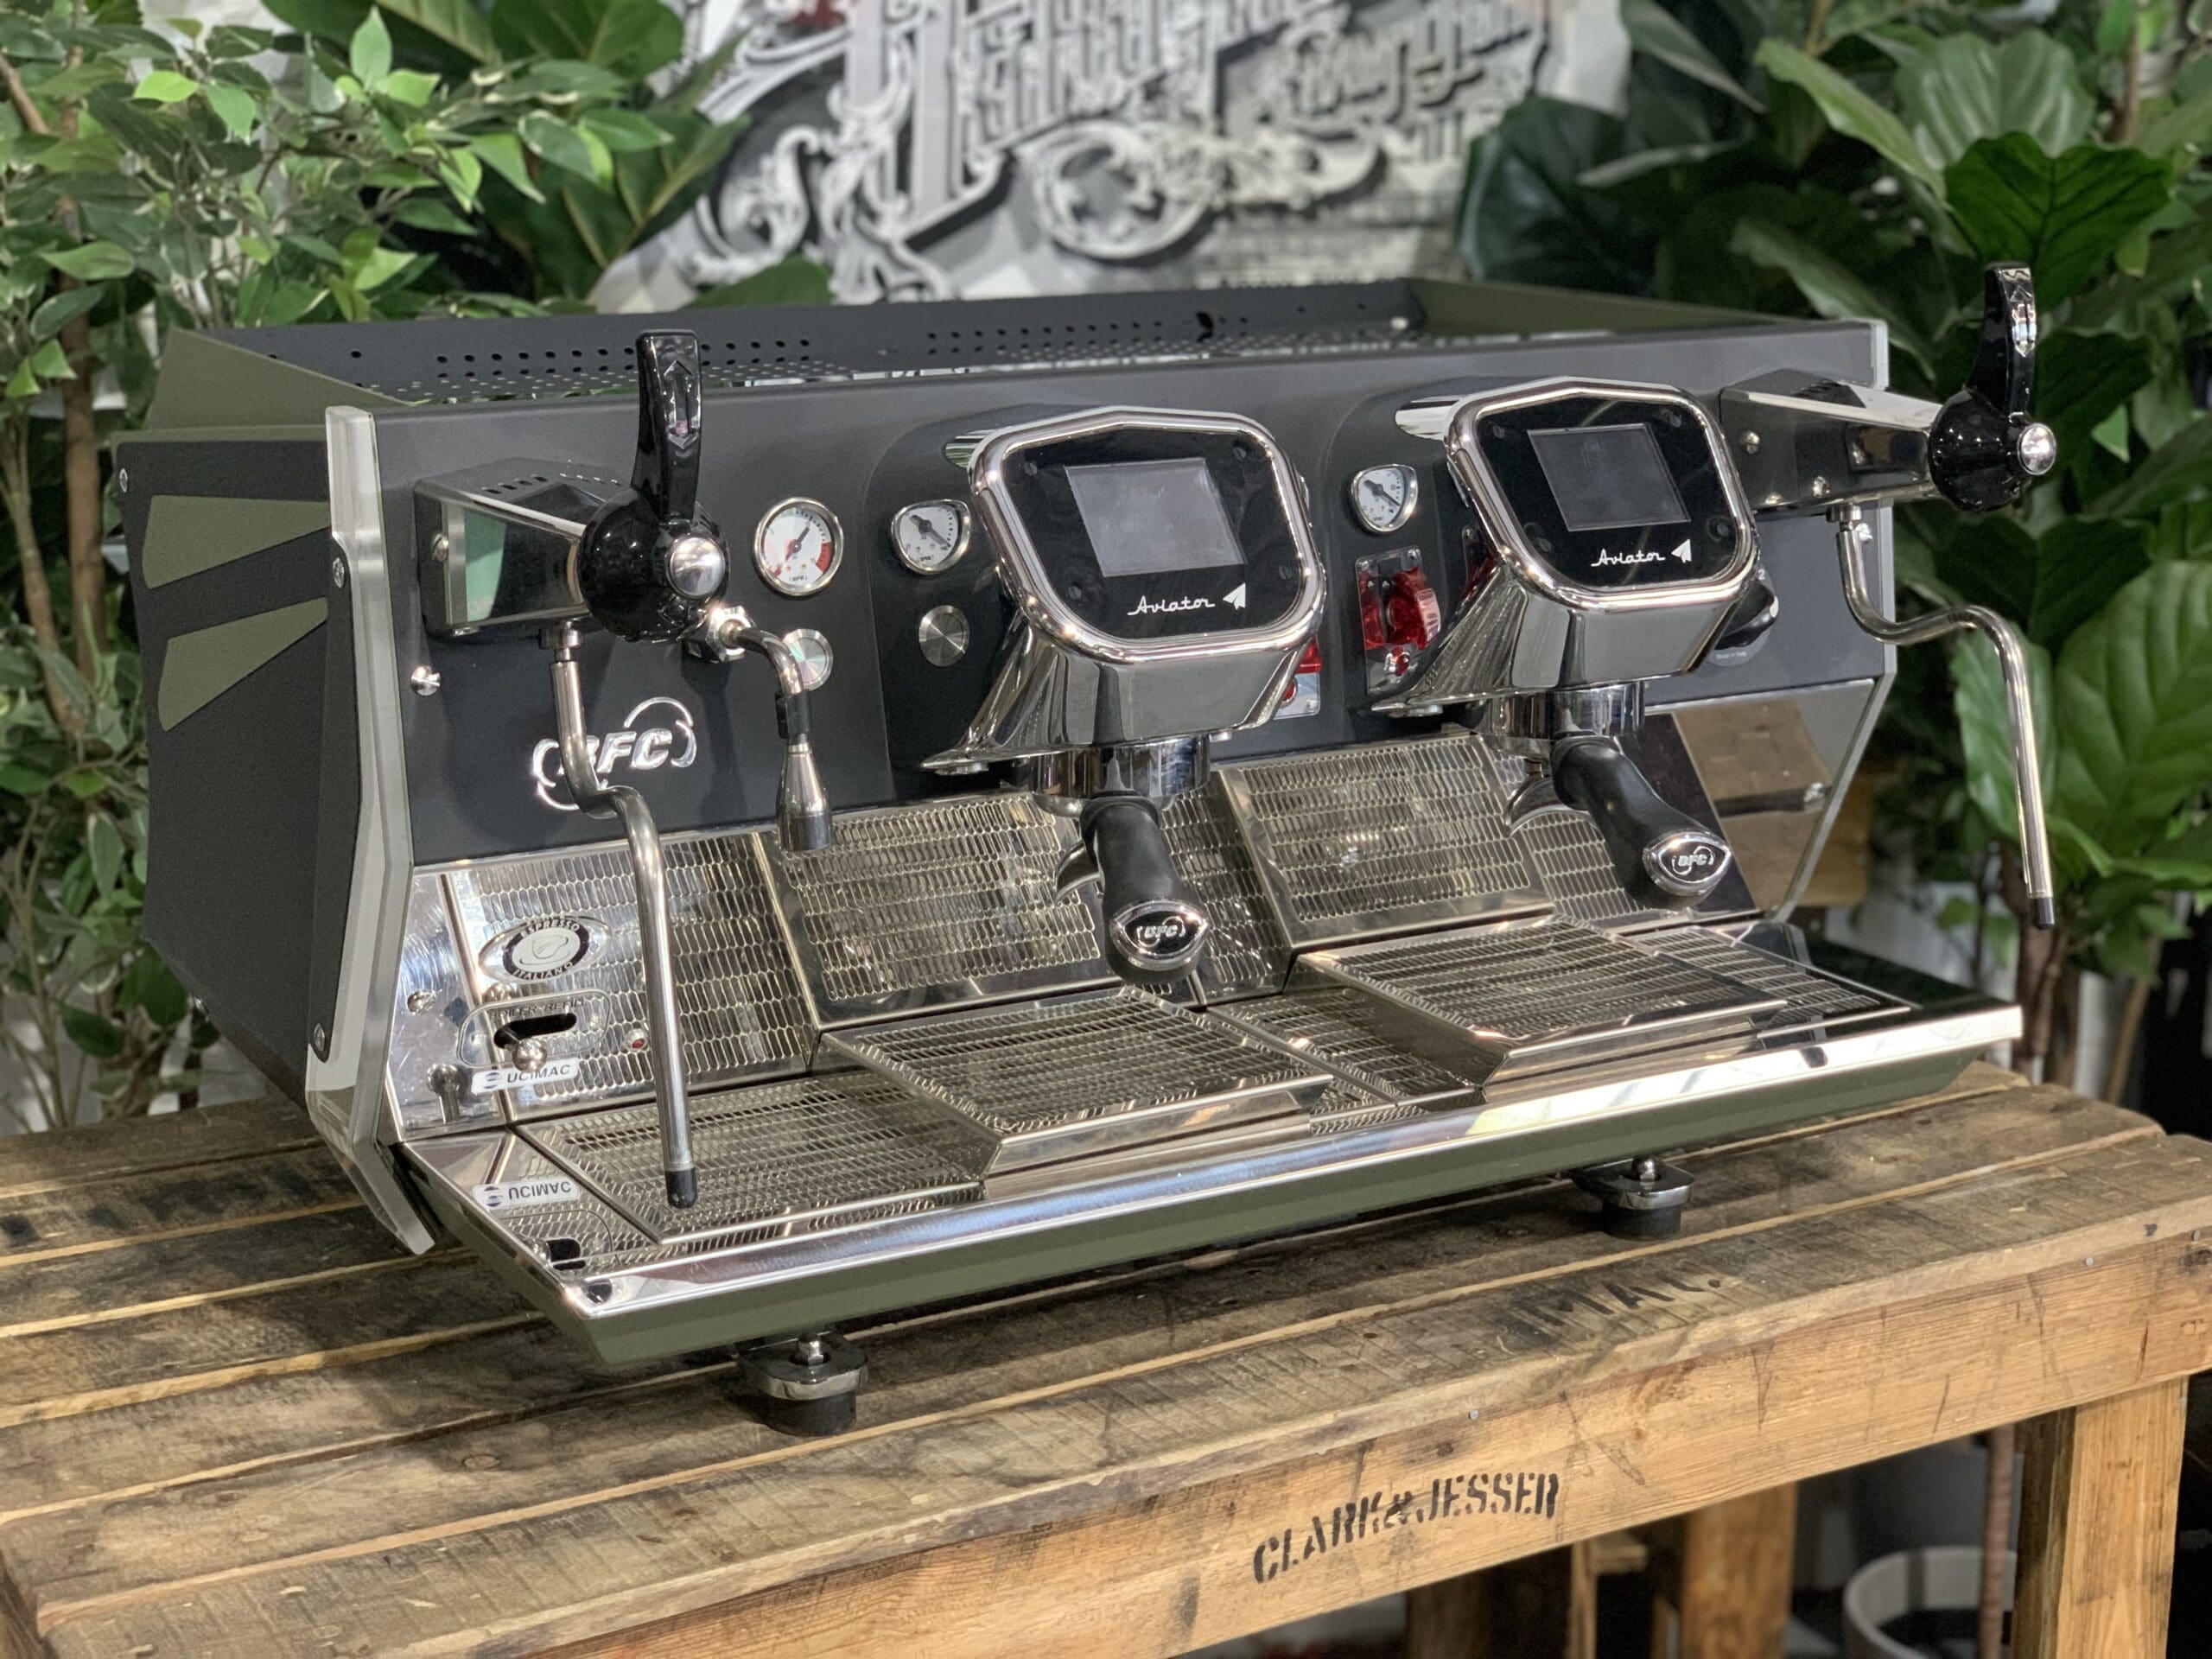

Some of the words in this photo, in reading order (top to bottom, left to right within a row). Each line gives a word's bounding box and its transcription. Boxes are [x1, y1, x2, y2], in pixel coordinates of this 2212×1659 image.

[1591, 548, 1666, 567] Aviator
[1127, 595, 1215, 615] Aviator
[520, 918, 580, 938] ESPRESSO
[513, 961, 574, 980] ITALIANO
